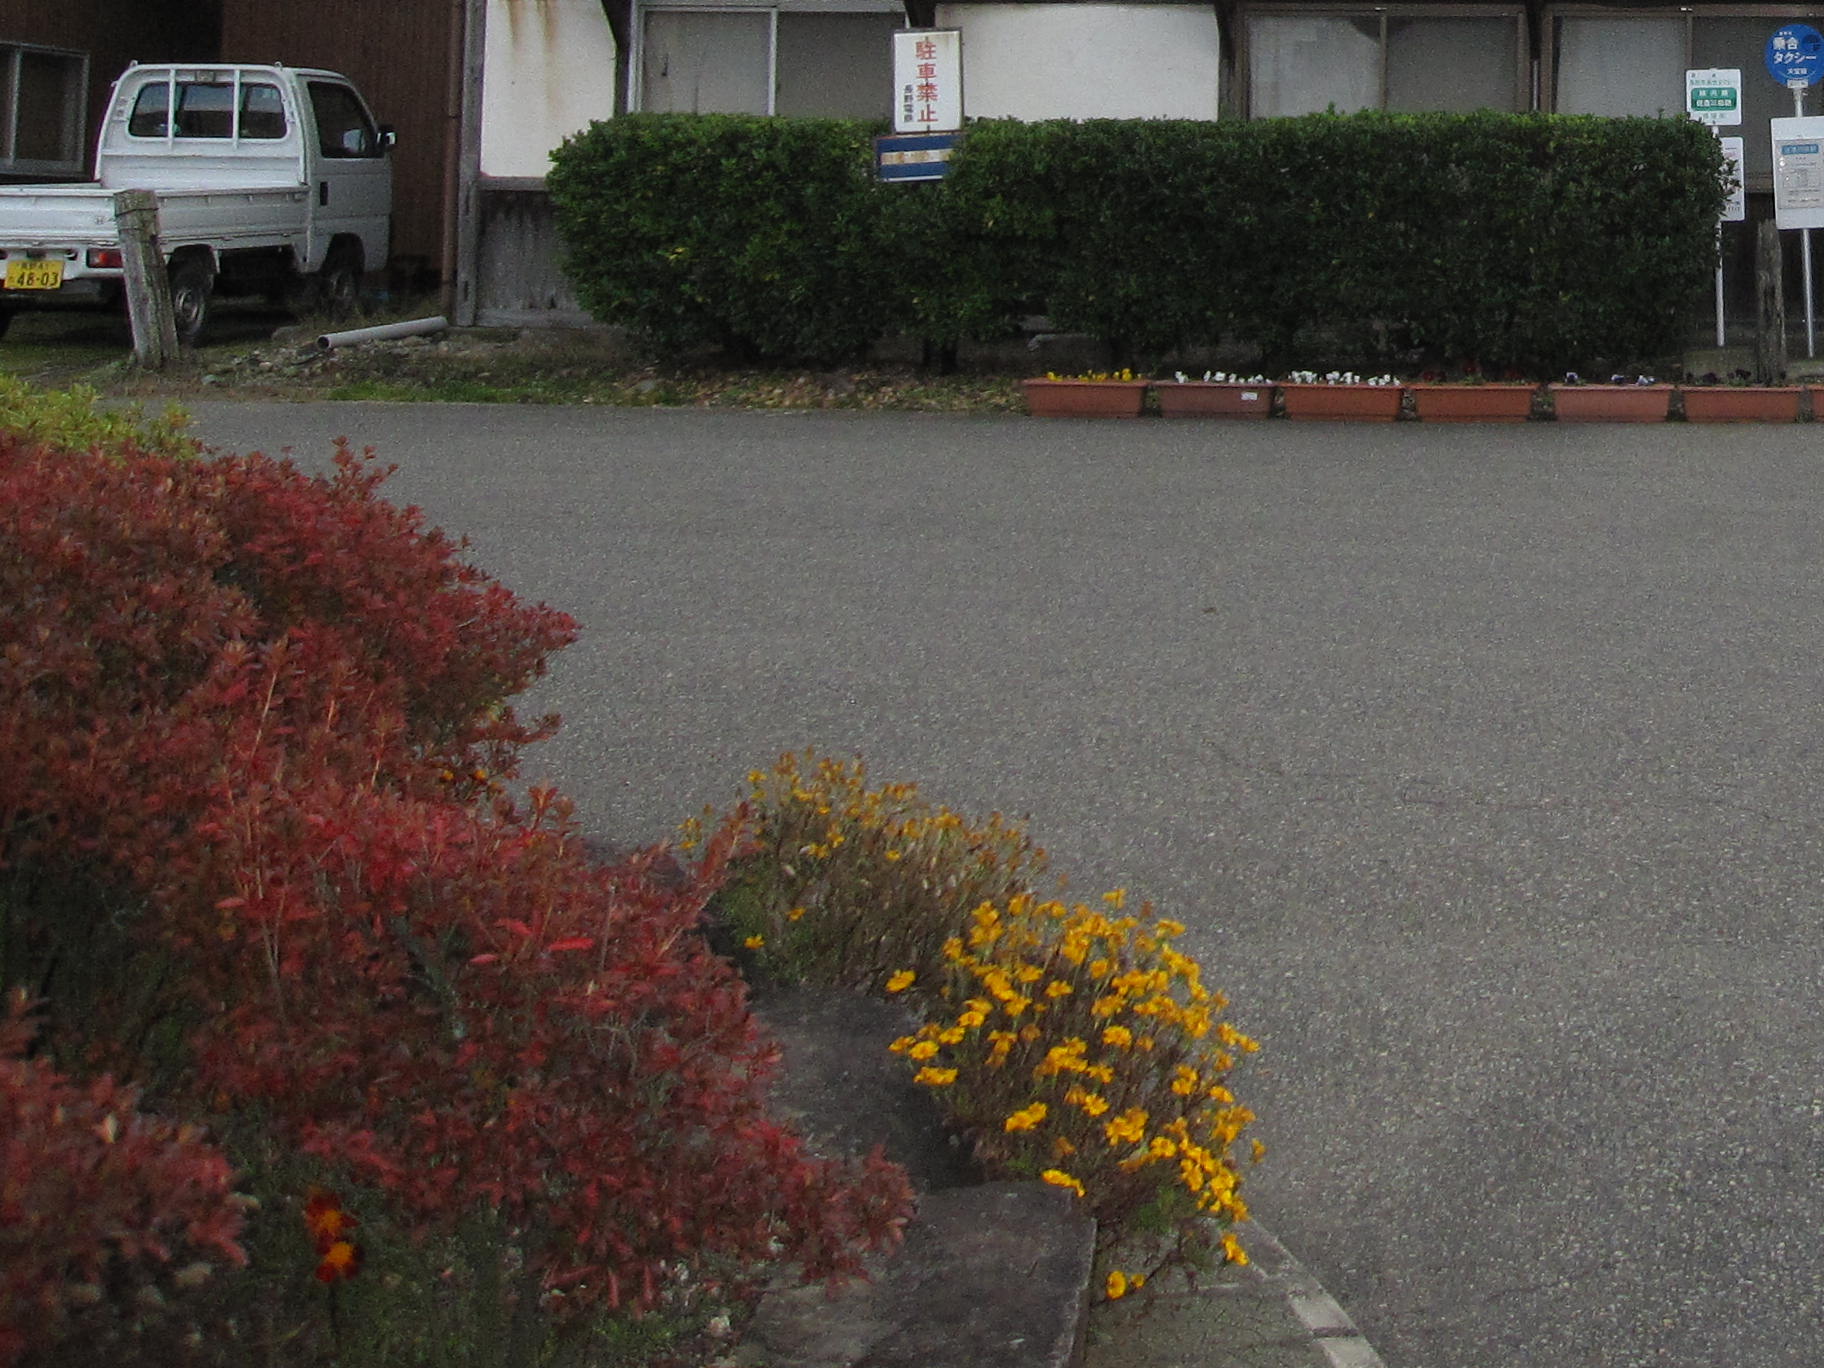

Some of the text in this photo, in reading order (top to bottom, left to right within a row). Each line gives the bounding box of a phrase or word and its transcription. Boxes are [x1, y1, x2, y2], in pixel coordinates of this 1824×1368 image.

[1772, 36, 1798, 50] 乗合
[1773, 52, 1817, 64] タクシー
[916, 36, 938, 122] 駐車禁止
